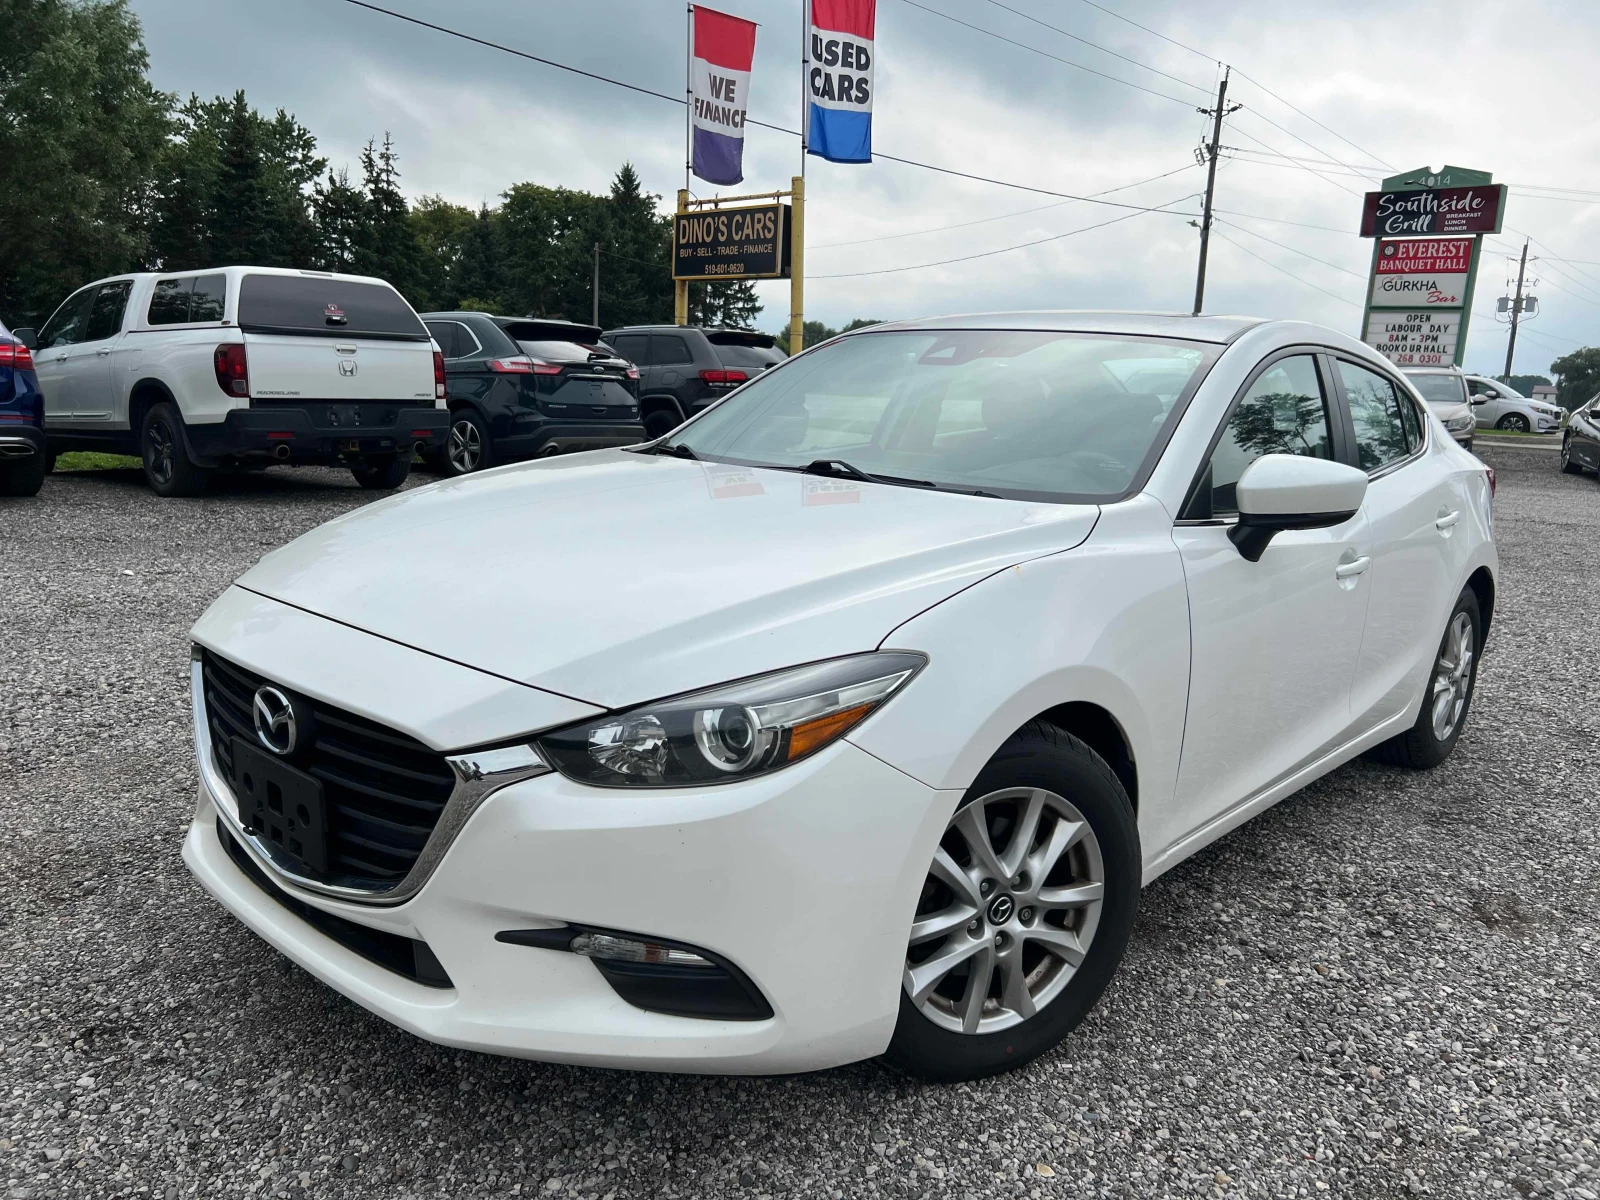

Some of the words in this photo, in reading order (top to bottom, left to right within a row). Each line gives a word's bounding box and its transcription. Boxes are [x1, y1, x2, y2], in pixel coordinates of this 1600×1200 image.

[811, 33, 871, 72] USED
[709, 72, 737, 103] WE
[810, 67, 870, 105] CARS
[1376, 191, 1486, 217] Southside
[679, 215, 728, 245] DINO'S
[732, 211, 775, 241] CARS
[1385, 214, 1432, 234] Grill
[680, 248, 693, 258] BUY
[697, 247, 713, 257] SELL
[717, 245, 739, 256] TRADE
[743, 243, 773, 254] FINANCE
[1397, 241, 1469, 258] EVEREST
[1380, 259, 1433, 272] BANQUET
[1435, 258, 1466, 270] HALL
[1383, 280, 1438, 292] GURKHA
[1426, 290, 1459, 304] Bar
[1406, 314, 1432, 323] OPEN
[1385, 324, 1423, 333] LABOUR
[1429, 324, 1450, 333] DAY
[1388, 334, 1408, 342] 8AM
[1419, 334, 1439, 343] 3PM
[1376, 343, 1401, 353] BOOK
[1423, 344, 1448, 354] HALL
[1397, 354, 1414, 363] 268
[1419, 354, 1442, 364] 0301
